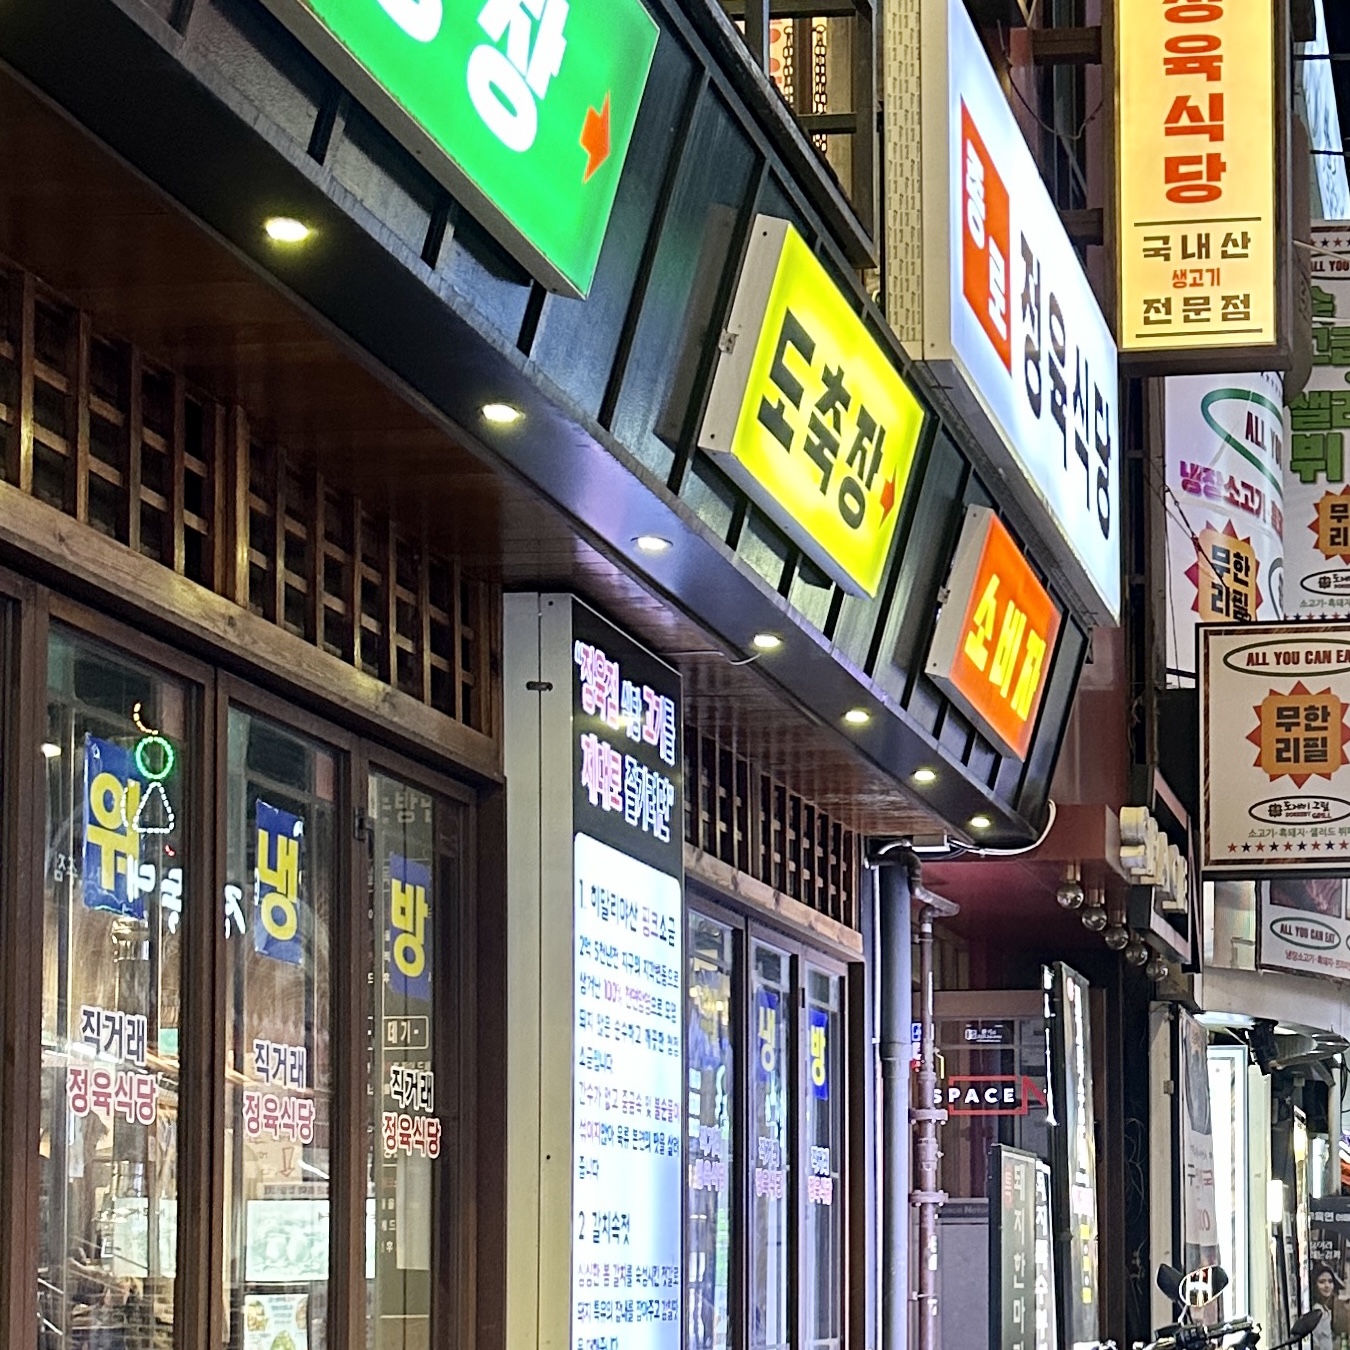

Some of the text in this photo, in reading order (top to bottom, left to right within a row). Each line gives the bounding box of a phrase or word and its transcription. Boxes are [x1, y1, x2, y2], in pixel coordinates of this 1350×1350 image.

[1142, 231, 1251, 261] 국내산
[1171, 267, 1221, 289] 생고기
[1142, 294, 1251, 325] 전문점
[1020, 230, 1110, 541] 정육식당
[757, 306, 887, 530] 도축장
[964, 574, 1048, 722] 소비자
[1246, 652, 1268, 667] ALL
[1274, 651, 1301, 666] YOU
[1305, 650, 1332, 665] CAN
[1275, 705, 1331, 733] 무한
[1274, 734, 1329, 764] 리필
[392, 879, 428, 978] 방
[1280, 923, 1292, 936] ALL
[80, 1005, 148, 1067] 직거래
[253, 1038, 309, 1092] 직거래
[66, 1066, 158, 1126] 정육식당
[389, 1065, 435, 1113] 직거래
[934, 1088, 1015, 1103] SPACE
[243, 1092, 315, 1144] 정육식당
[382, 1113, 441, 1160] 정육식당
